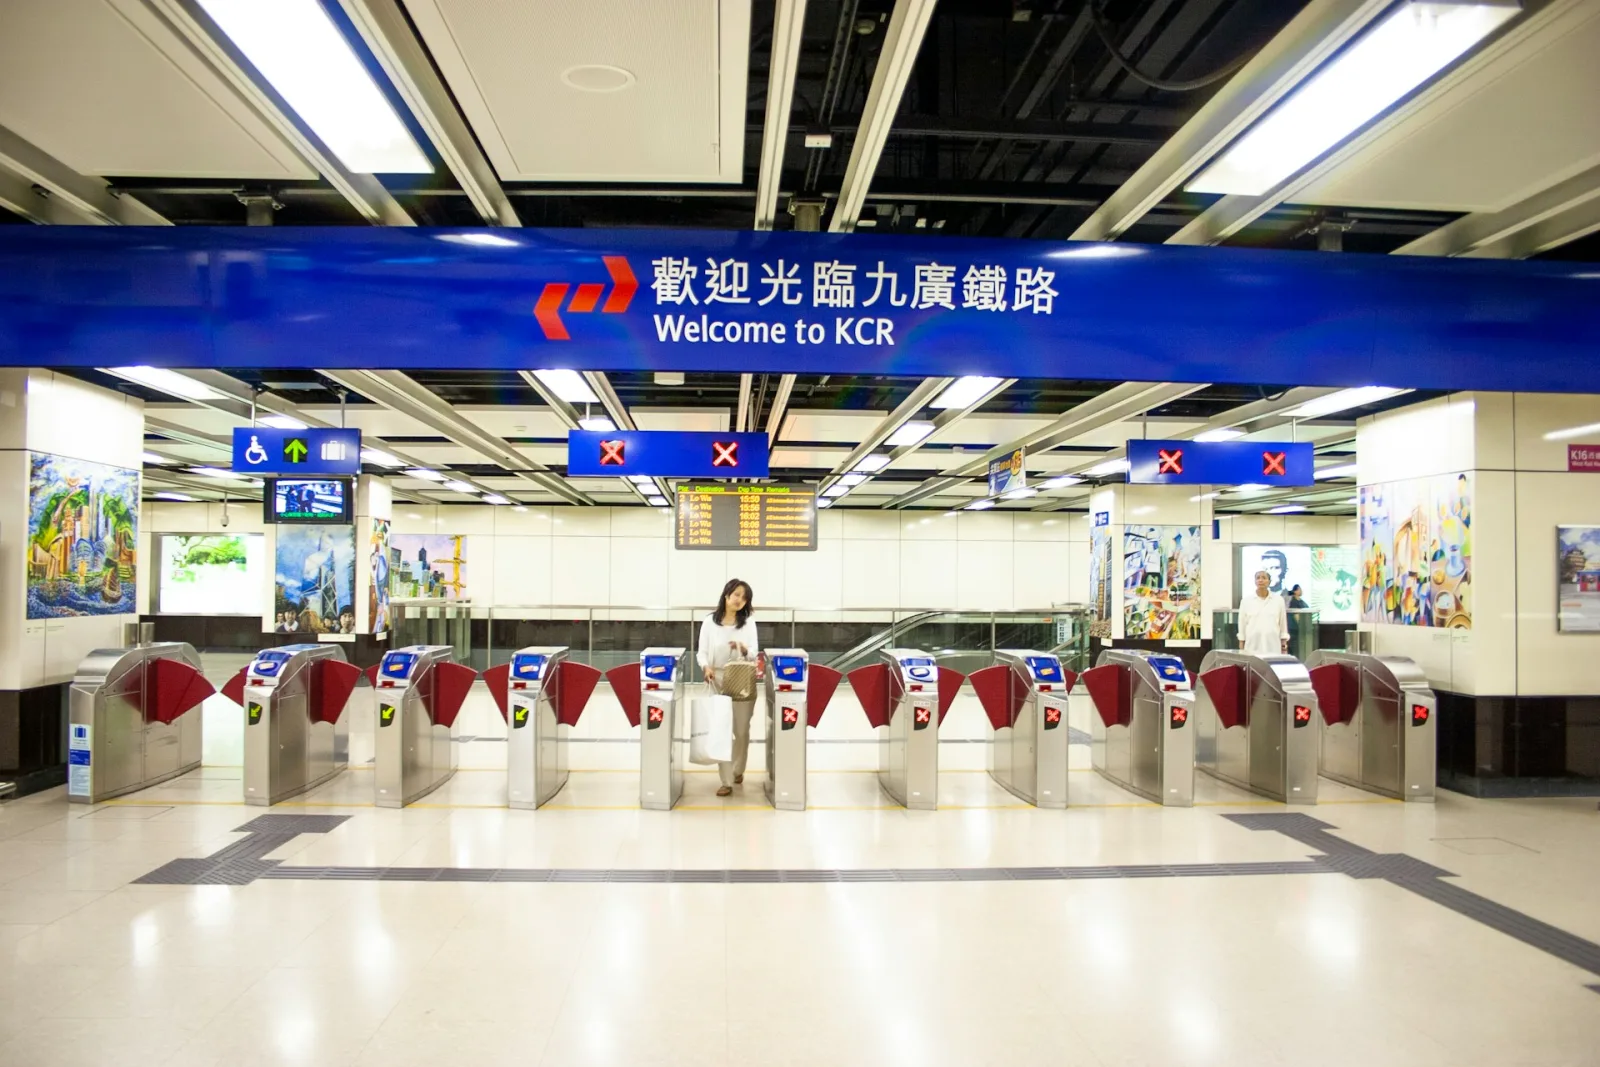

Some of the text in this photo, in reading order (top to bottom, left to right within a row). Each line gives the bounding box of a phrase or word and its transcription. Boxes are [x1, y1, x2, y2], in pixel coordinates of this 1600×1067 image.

[650, 256, 1059, 315] 歡迎光臨九廣鐵路
[653, 314, 895, 346] Welcome to KCR
[1570, 450, 1588, 460] K16
